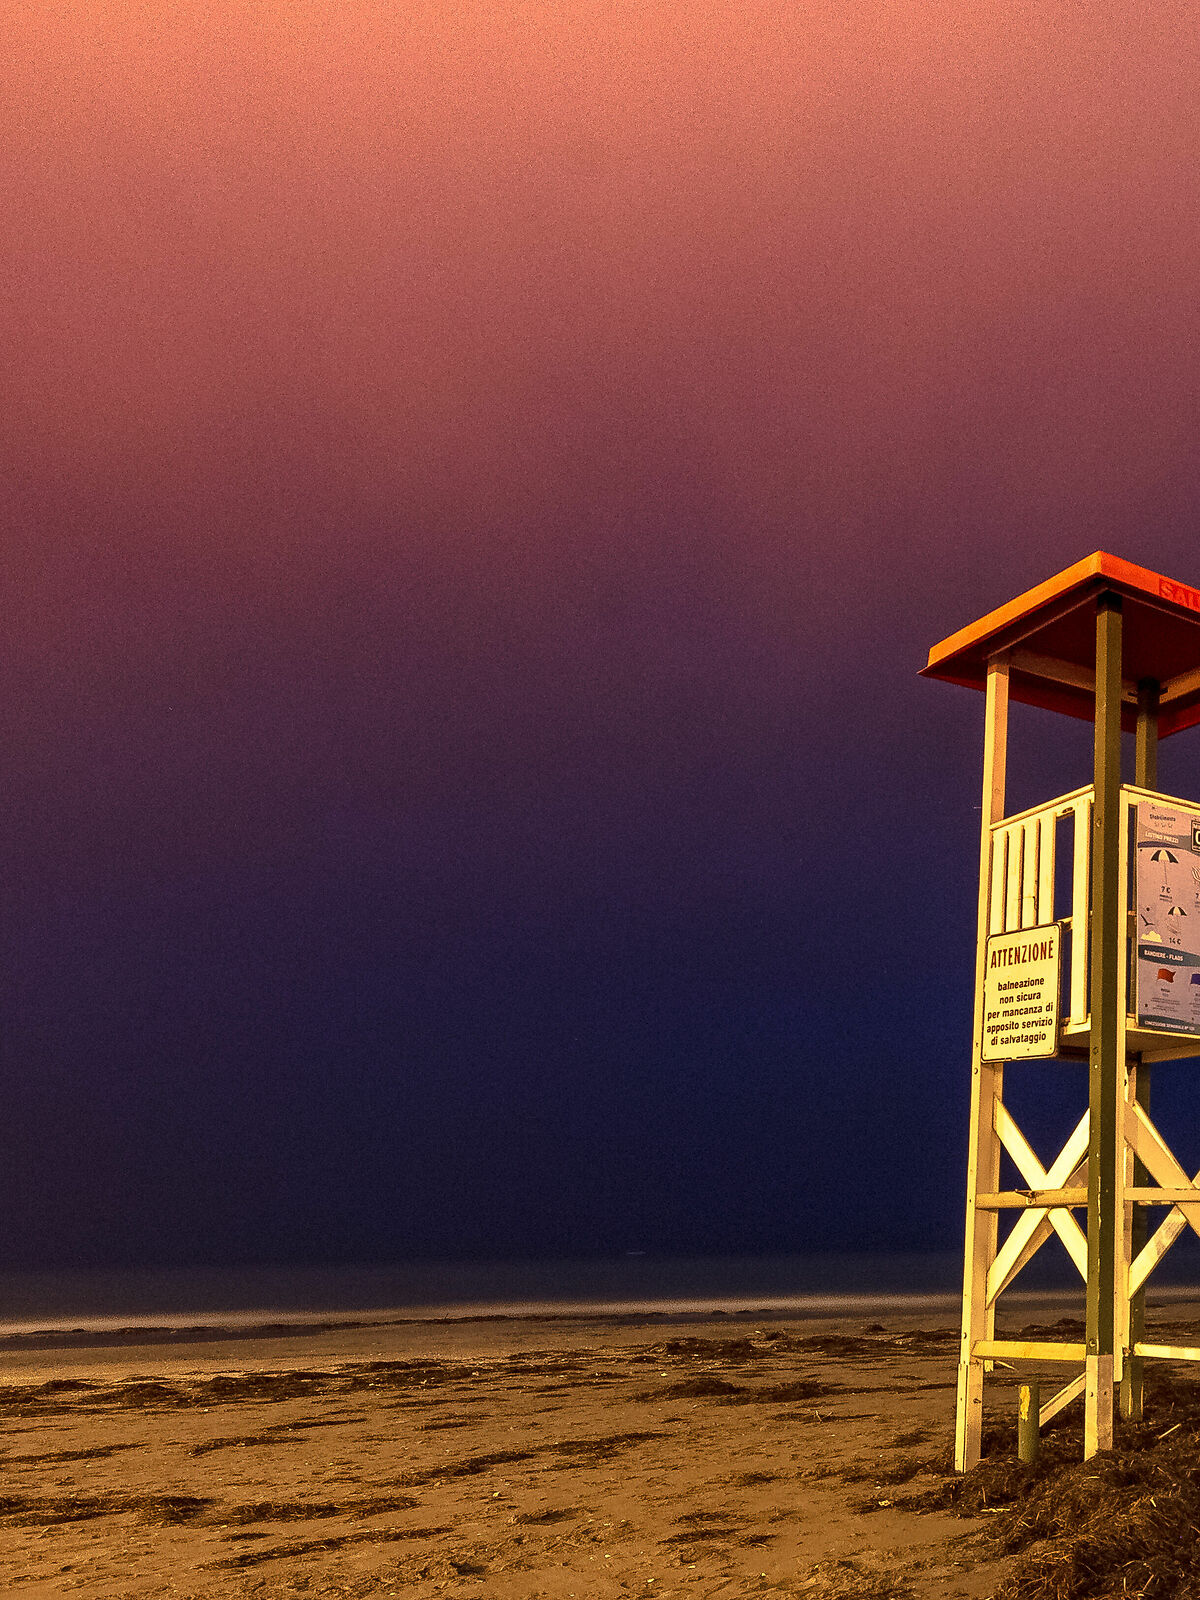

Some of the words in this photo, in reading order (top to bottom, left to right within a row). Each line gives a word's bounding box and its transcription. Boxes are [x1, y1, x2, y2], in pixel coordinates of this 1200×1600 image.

[990, 939, 1054, 968] ATTENZIONE
[997, 976, 1045, 991] balneazione
[999, 994, 1014, 1004] non
[1016, 991, 1041, 1002] sicura
[987, 1010, 1000, 1021] per
[1002, 1004, 1043, 1017] mancanza
[1045, 1002, 1054, 1012] di
[986, 1020, 1020, 1034] apposito
[1022, 1017, 1053, 1029] servizio
[990, 1035, 999, 1045] di
[1000, 1032, 1047, 1045] salvataggio
